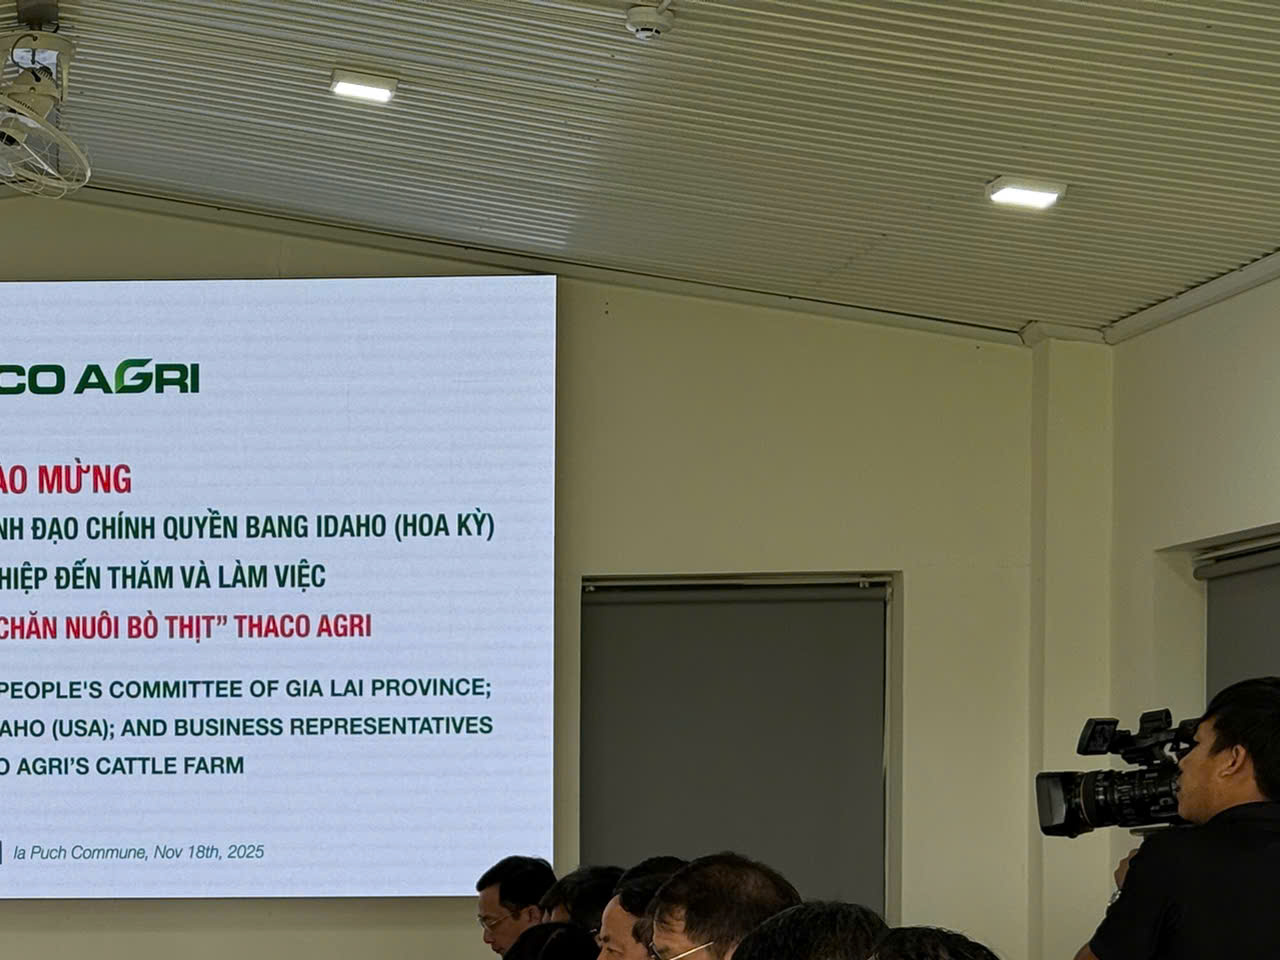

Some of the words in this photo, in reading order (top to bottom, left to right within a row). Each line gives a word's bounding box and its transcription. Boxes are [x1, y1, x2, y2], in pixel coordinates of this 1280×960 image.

[73, 358, 200, 394] AGRI
[38, 457, 132, 495] MỪNG
[30, 515, 79, 545] ĐẠO
[86, 510, 156, 540] CHÍNH
[162, 507, 238, 542] QUYỀN
[245, 514, 309, 539] BANG
[316, 513, 387, 538] IDAHO
[394, 512, 450, 542] (HOA
[457, 507, 495, 542] KỲ)
[54, 557, 101, 590] ĐẾN
[106, 559, 174, 590] THĂM
[179, 559, 212, 589] VÀ
[218, 559, 268, 589] LÀM
[273, 558, 326, 593] VIỆC
[65, 610, 119, 640] NUÔI
[127, 609, 159, 639] BÒ
[233, 614, 311, 638] THACO
[316, 613, 372, 638] AGRI
[108, 679, 243, 699] COMMITTEE
[249, 679, 280, 698] OF
[285, 679, 324, 698] GIA
[330, 679, 364, 697] LAI
[371, 677, 491, 700] PROVINCE;
[52, 718, 115, 742] (USA);
[120, 718, 168, 737] AND
[174, 716, 284, 737] BUSINESS
[290, 716, 494, 736] REPRESENTATIVES
[95, 756, 177, 776] CATTLE
[183, 756, 244, 775] FARM
[30, 845, 67, 860] Puch
[71, 844, 149, 862] Commune,
[153, 844, 184, 860] Nov
[189, 844, 222, 861] 18th,
[227, 844, 265, 859] 2025
